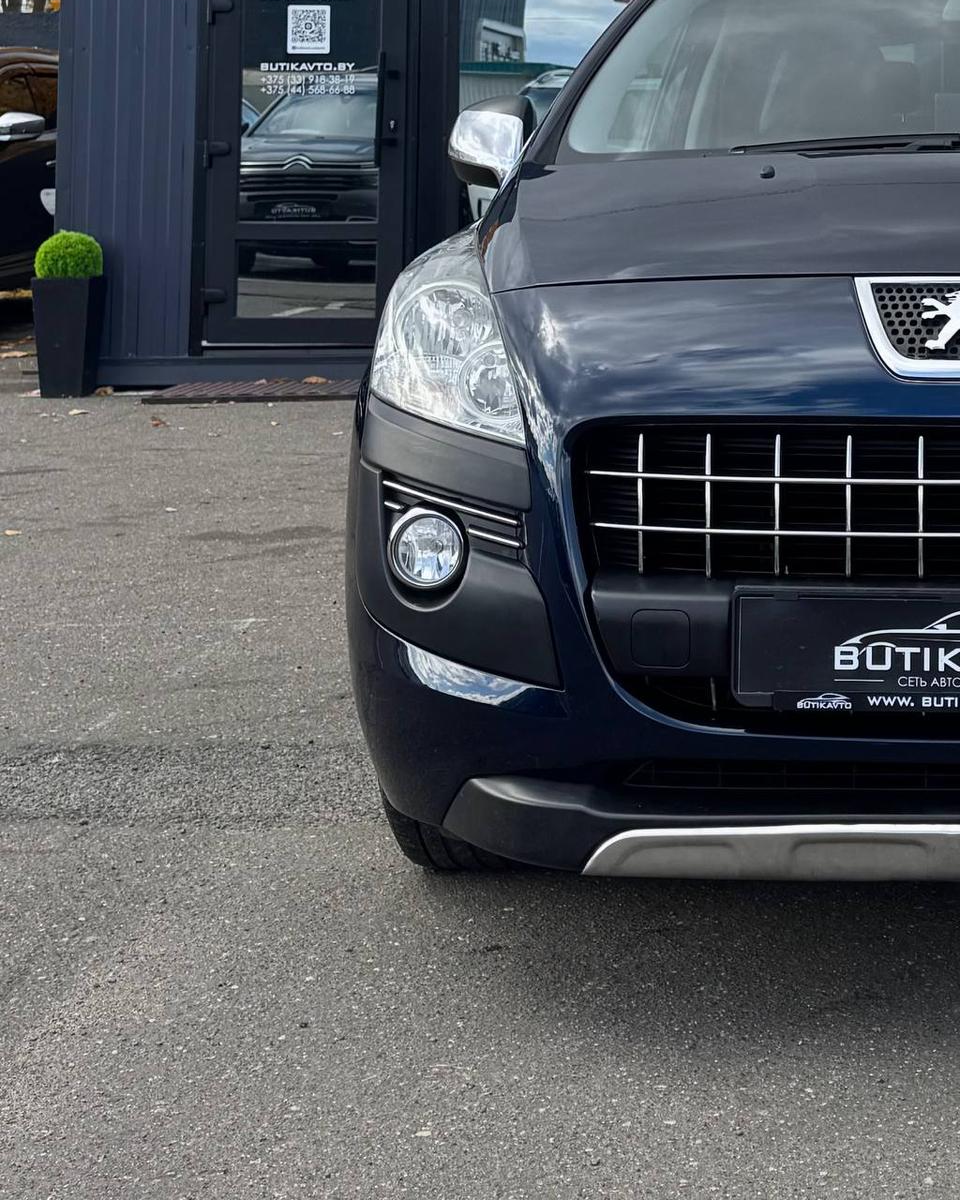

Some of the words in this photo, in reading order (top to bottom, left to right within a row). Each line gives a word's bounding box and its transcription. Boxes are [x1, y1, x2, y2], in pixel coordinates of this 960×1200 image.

[260, 62, 356, 72] BUTIKAVTO.BY
[260, 74, 284, 84] +375
[260, 84, 284, 94] +375
[287, 84, 306, 96] (44)
[897, 676, 928, 687] СЕТЬ
[796, 701, 853, 710] BUTIKAVTO
